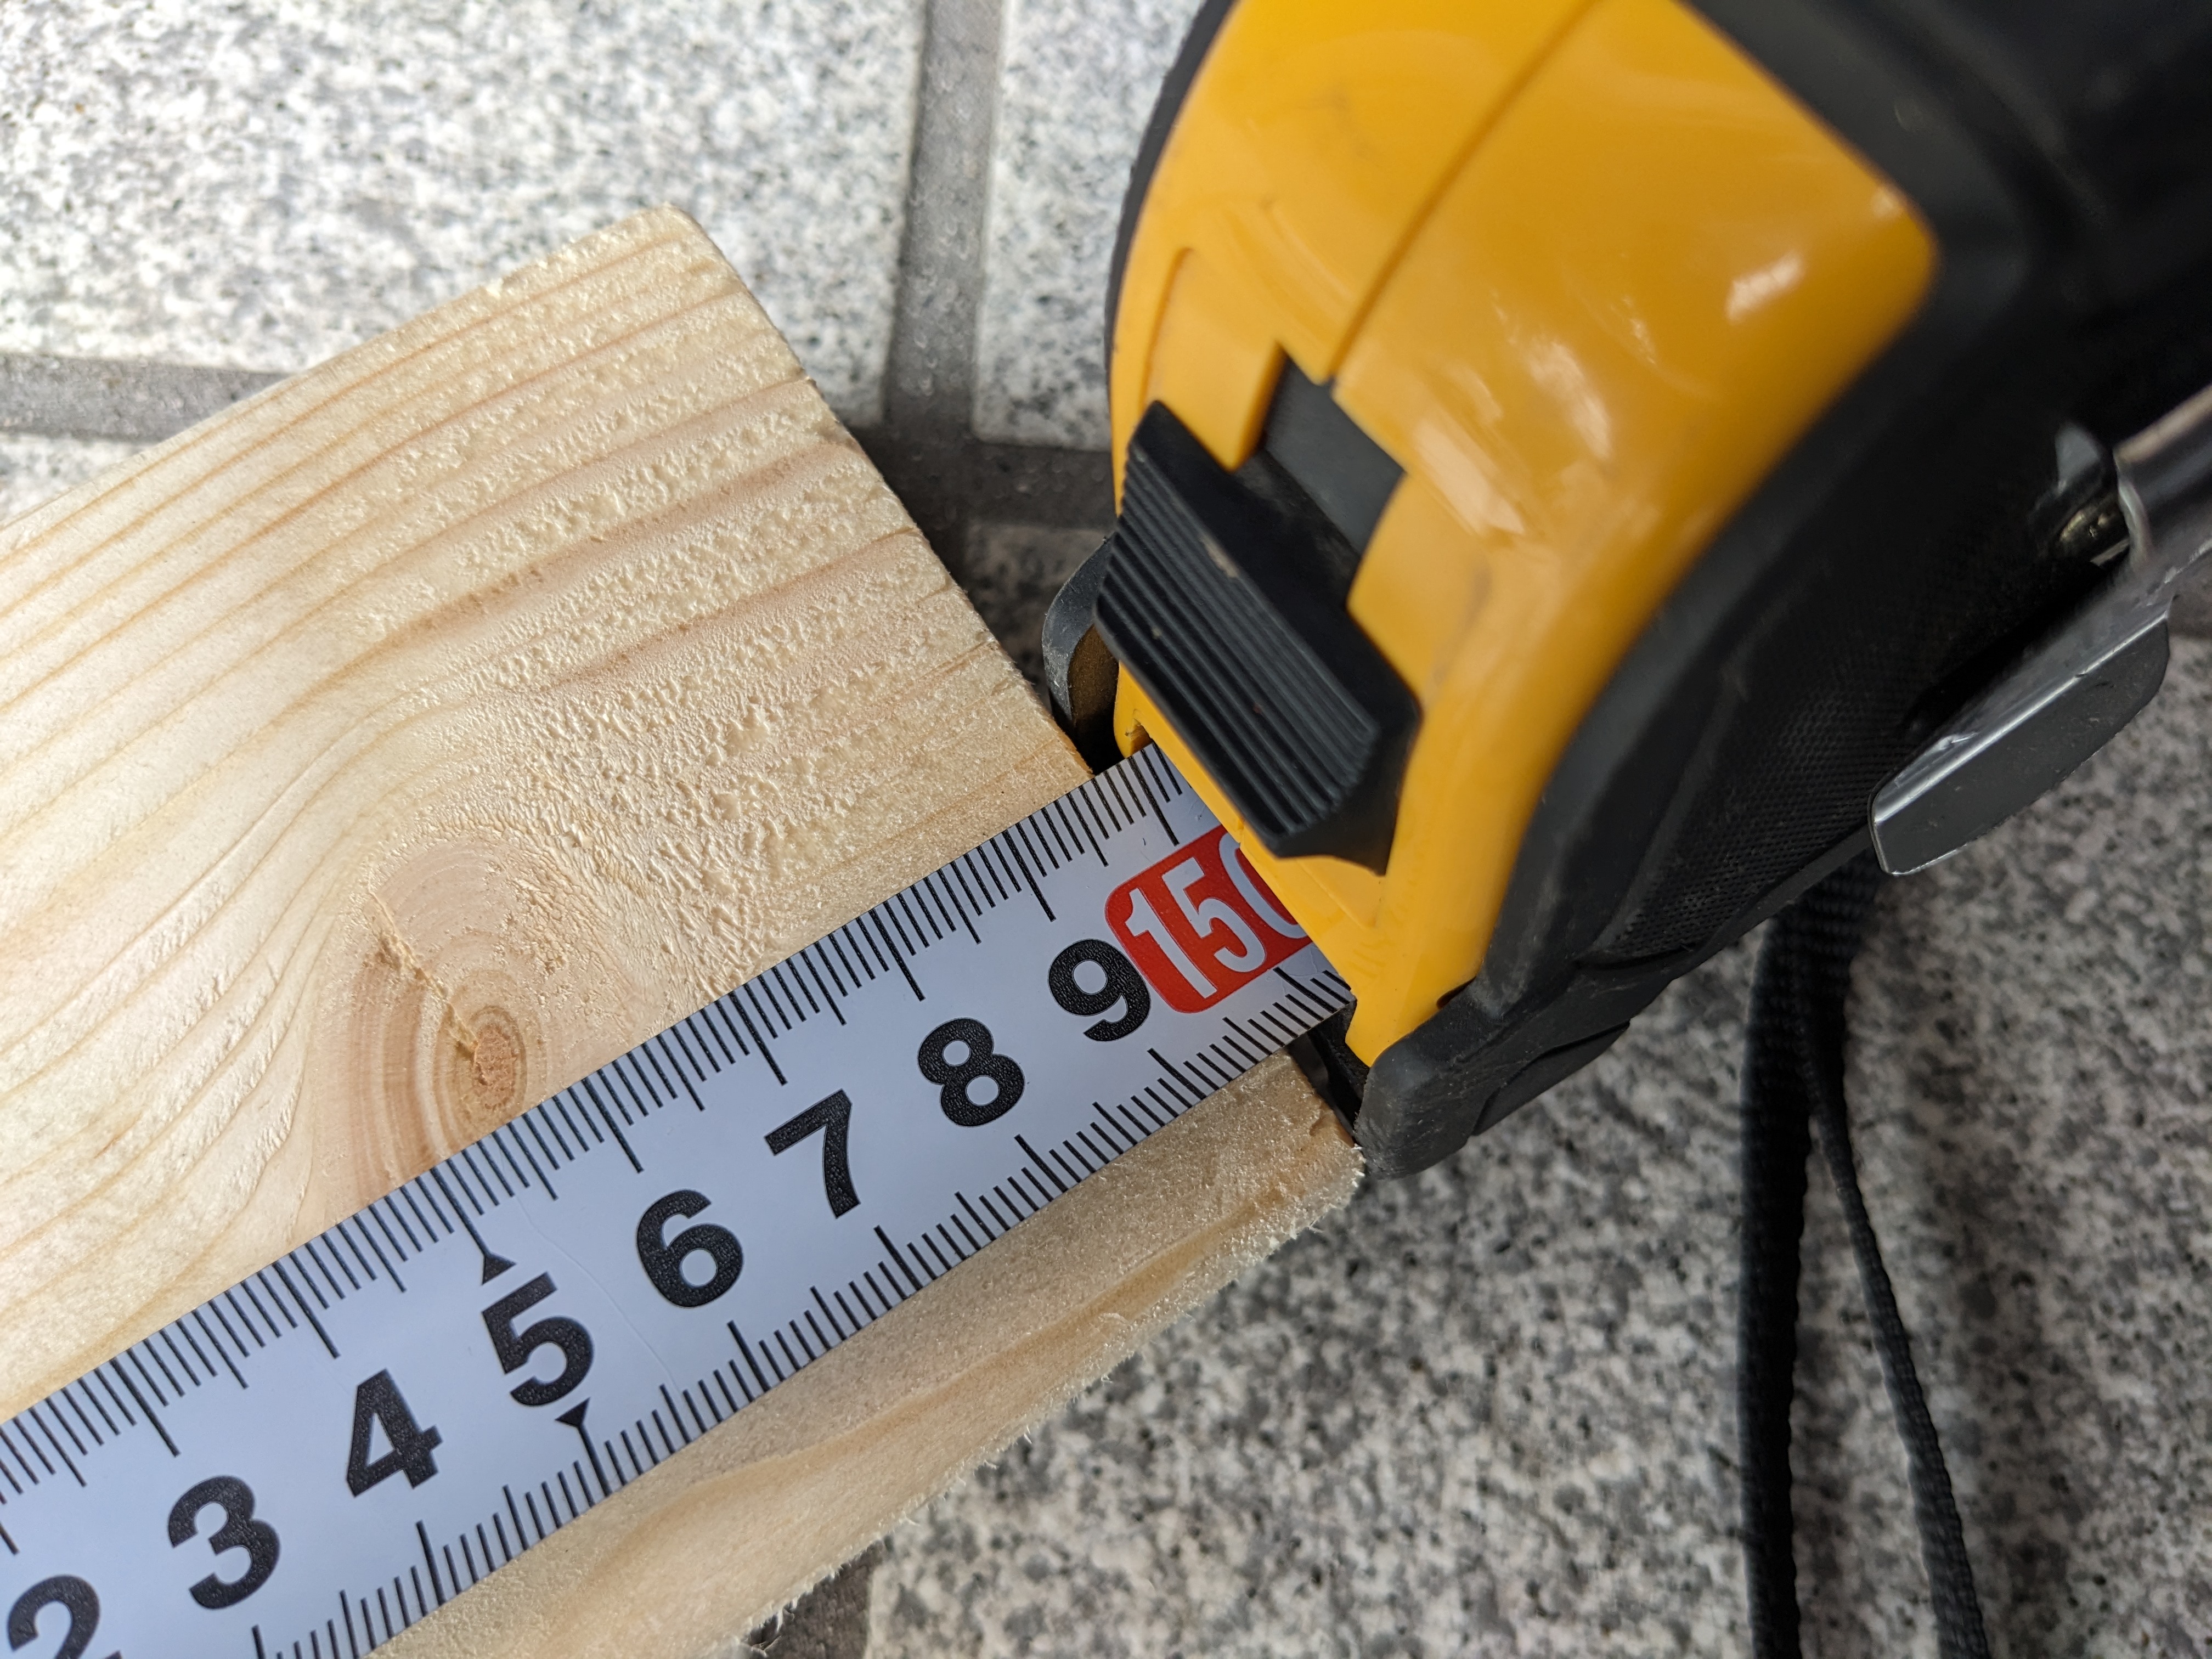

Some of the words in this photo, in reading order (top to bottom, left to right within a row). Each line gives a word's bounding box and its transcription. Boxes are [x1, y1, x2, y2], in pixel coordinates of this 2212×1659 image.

[7, 1574, 123, 1659] 2
[167, 1475, 281, 1610] 3
[346, 1368, 443, 1498] 4
[481, 1271, 595, 1407] 5
[636, 1188, 744, 1309] 6
[763, 1088, 862, 1219] 7
[917, 1017, 1026, 1128] 8
[1047, 938, 1152, 1042] 9
